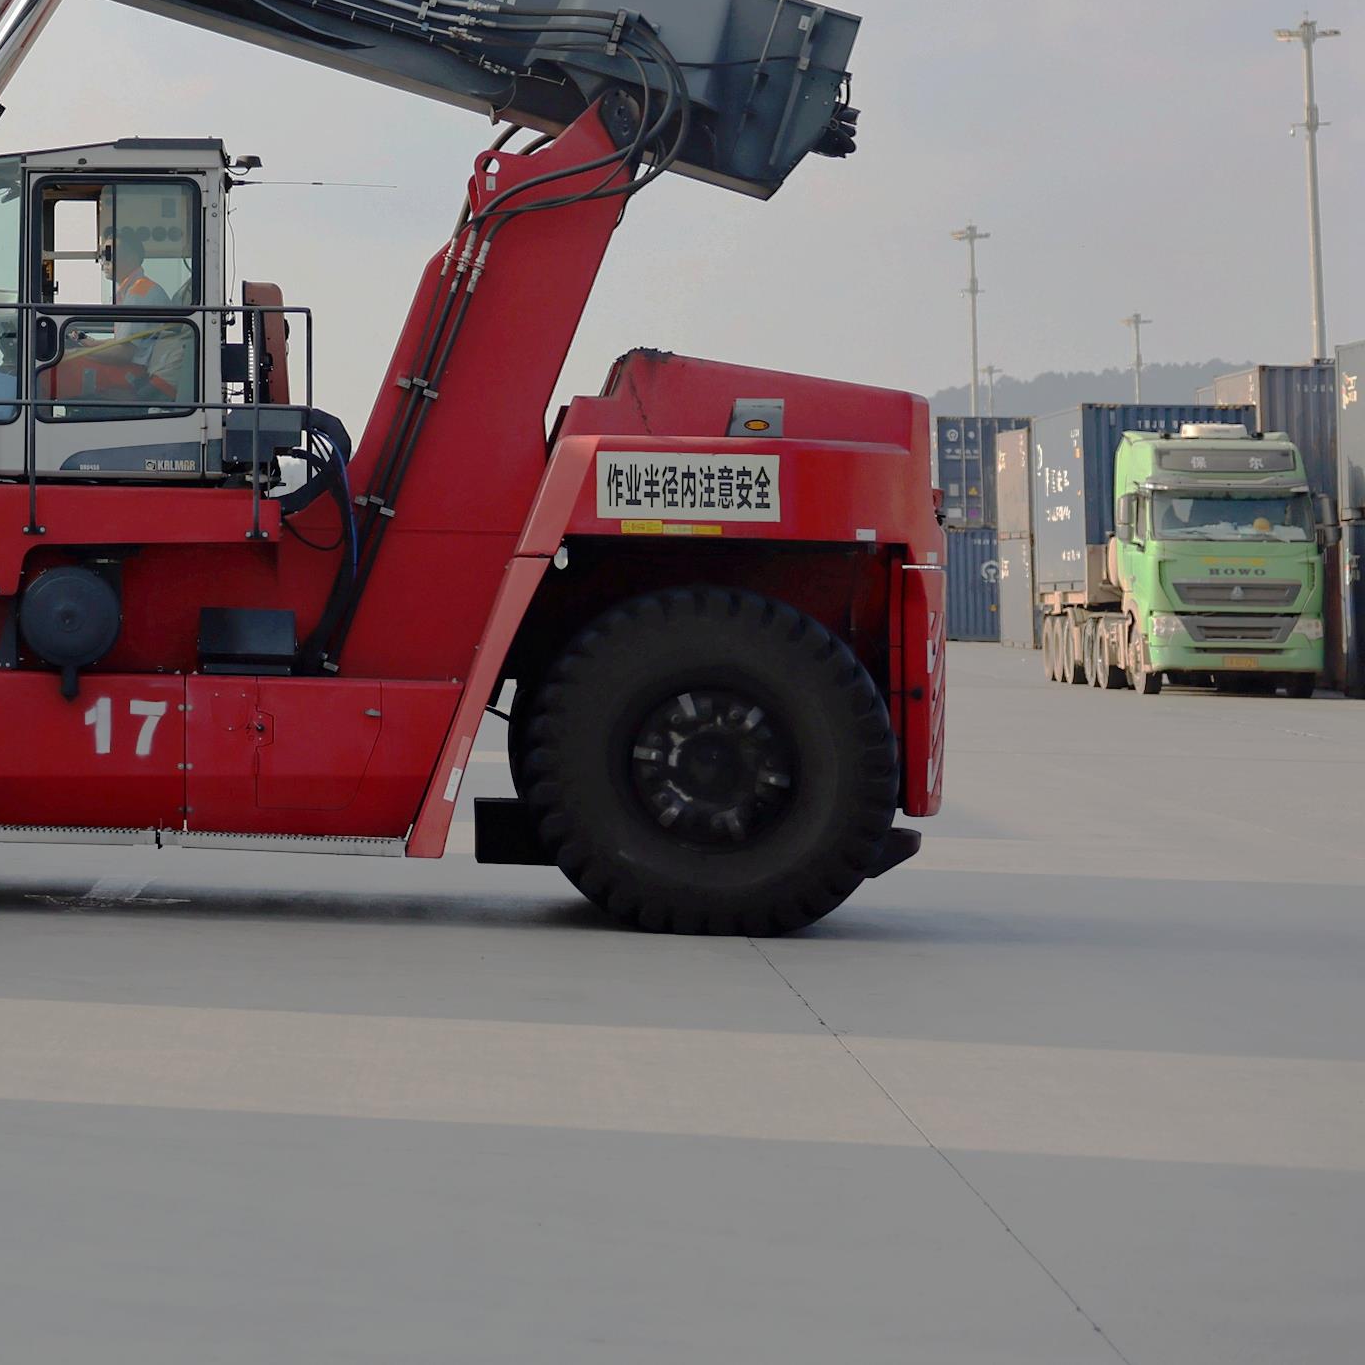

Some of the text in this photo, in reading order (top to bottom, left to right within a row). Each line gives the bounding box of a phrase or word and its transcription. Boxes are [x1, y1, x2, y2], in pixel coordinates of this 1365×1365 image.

[158, 459, 197, 471] KALMAR
[607, 463, 771, 510] 作业半径内注意安全
[1208, 567, 1267, 577] HOWO
[84, 696, 167, 756] 17
